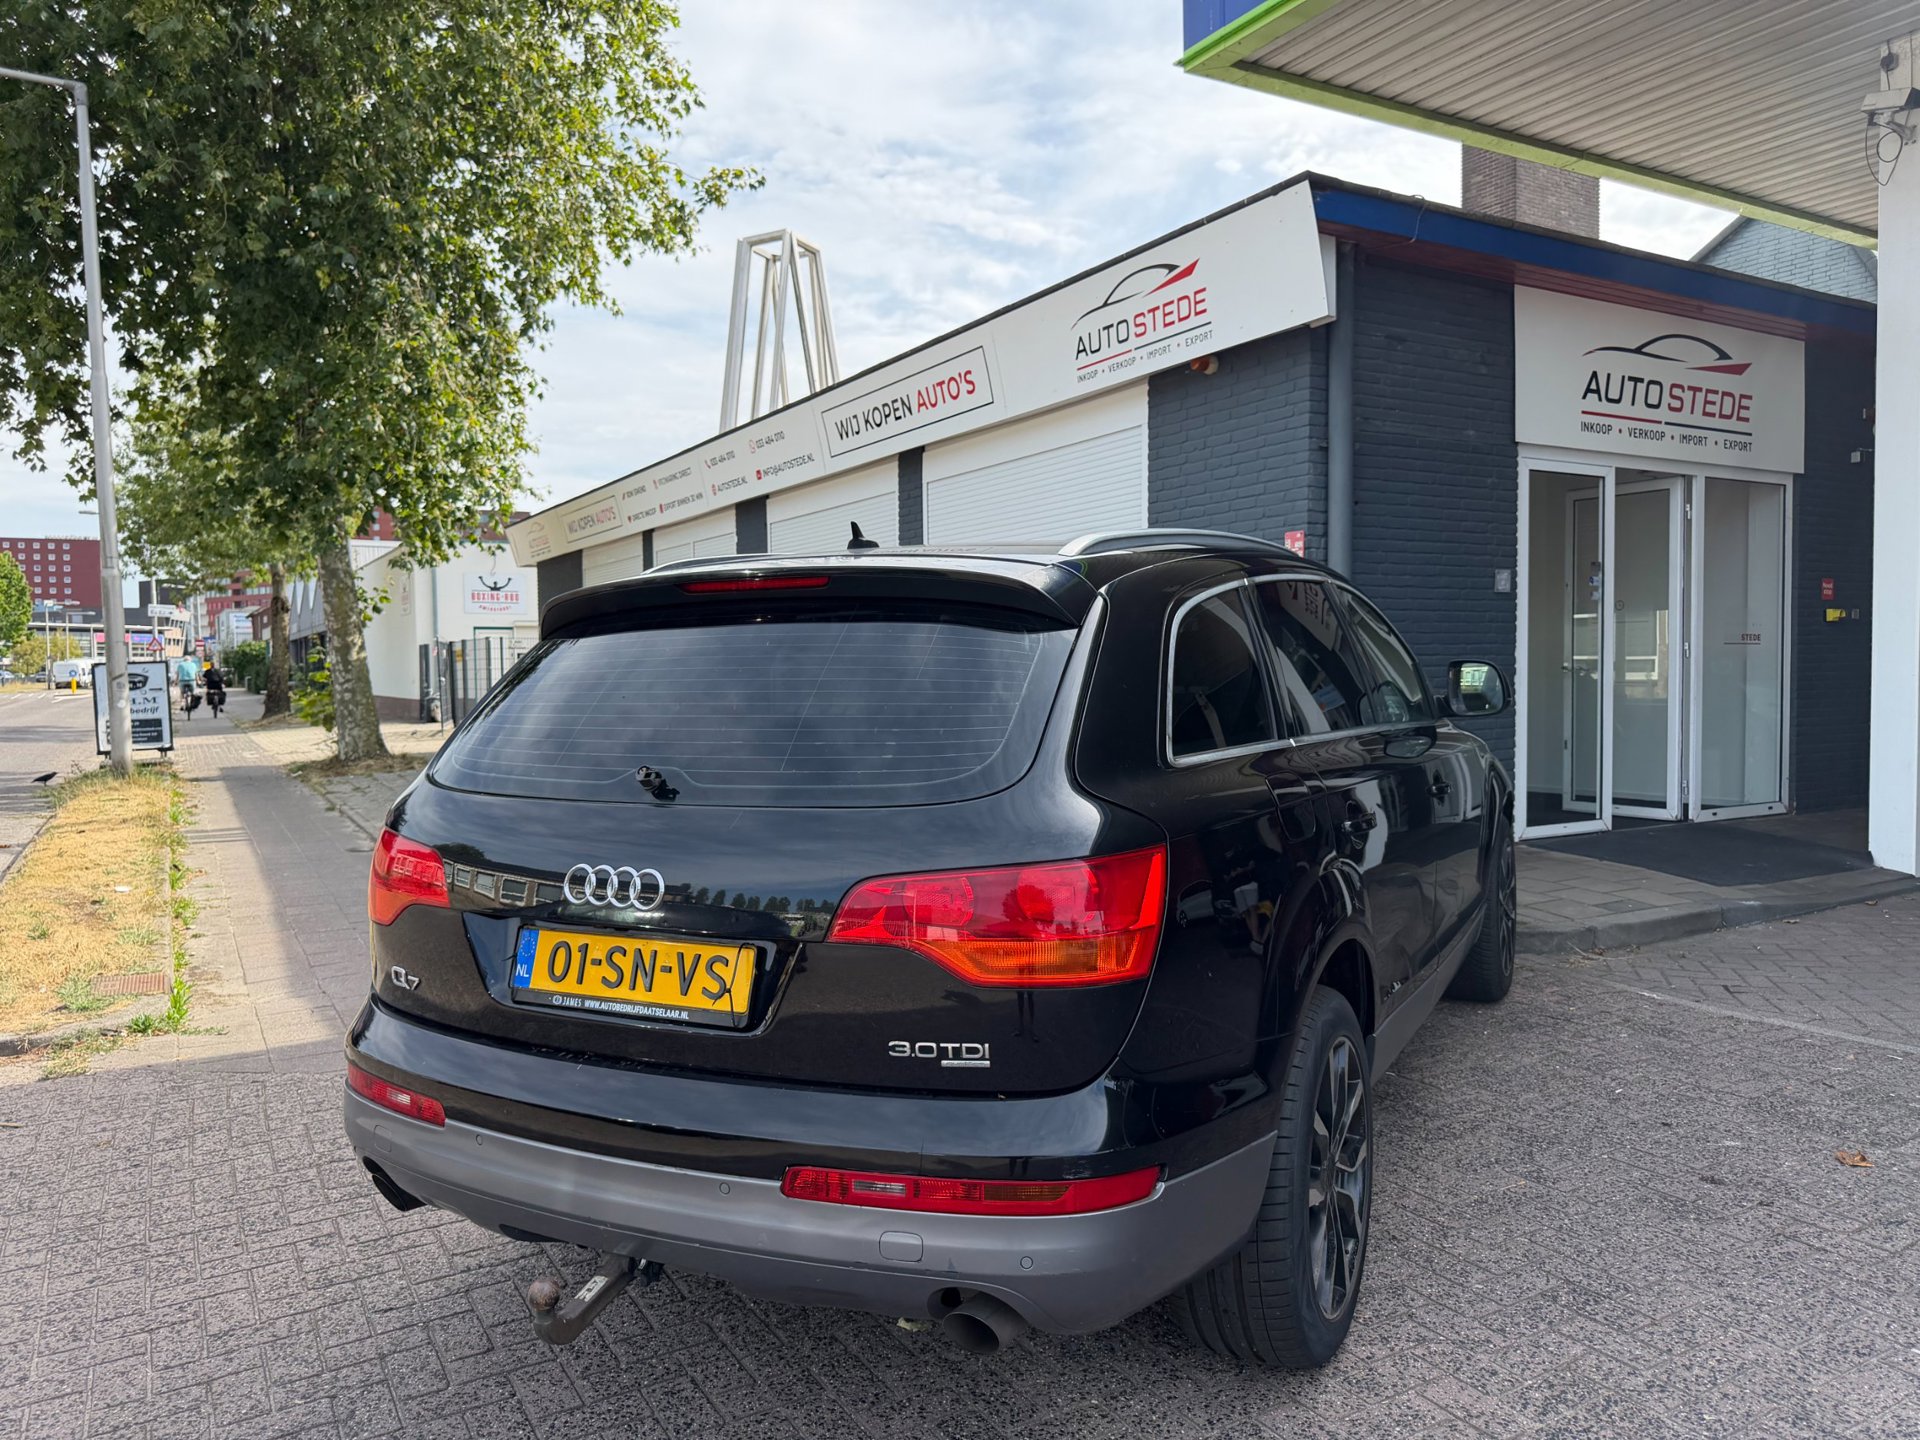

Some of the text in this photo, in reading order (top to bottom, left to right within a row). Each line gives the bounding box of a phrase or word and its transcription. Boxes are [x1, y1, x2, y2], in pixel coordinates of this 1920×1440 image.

[1077, 329, 1214, 384] INKOOP VERKOOP IMPORT EXPORT
[834, 369, 976, 441] WIJ KOPEN AUTO'S
[1580, 421, 1753, 453] INKOOP VERKOOP IMPORT EXPORT
[762, 452, 815, 477] INFO@AUTOSTEDE.NL
[717, 475, 748, 492] AUTOSTEDE.NL
[1740, 633, 1761, 642] STEDE
[391, 965, 420, 990] Q7
[515, 963, 530, 978] NL
[547, 939, 729, 1001] 01-SN-VS
[584, 999, 690, 1020] WWW.AUTOBEDRIJFDAATSELAAR.NL
